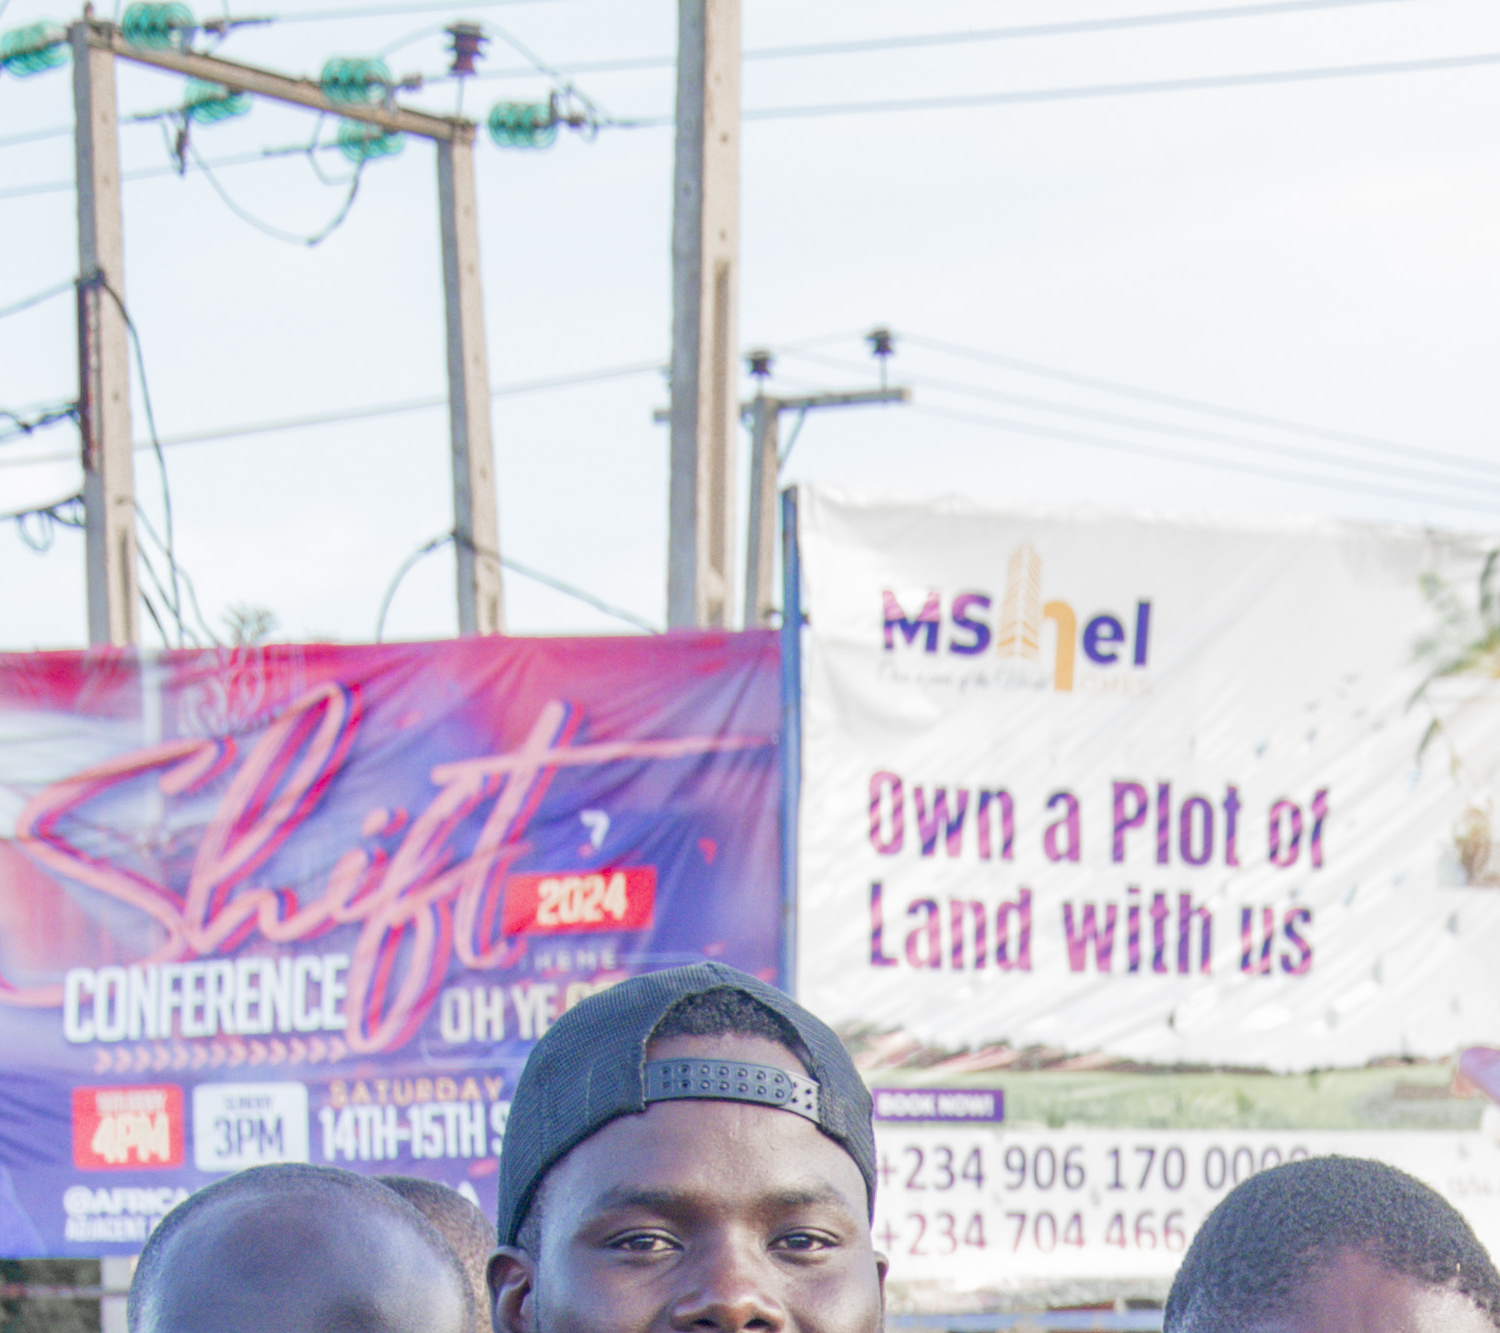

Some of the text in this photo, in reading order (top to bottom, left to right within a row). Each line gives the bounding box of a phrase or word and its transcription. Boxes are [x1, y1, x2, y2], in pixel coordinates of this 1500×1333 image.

[866, 772, 1331, 871] Own a Plot of
[536, 871, 628, 927] 2024
[868, 879, 1316, 978] Land with us
[63, 954, 350, 1043] CONFERENCE
[441, 986, 504, 1043] OH
[511, 982, 557, 1041] YE
[329, 1076, 505, 1109] SATURDAY
[90, 1114, 171, 1164] 4PM
[213, 1114, 286, 1159] 3PM
[318, 1102, 486, 1161] 14TH-15TH
[878, 1145, 1188, 1192] +234 906 170
[878, 1210, 1187, 1257] +234 704 466
